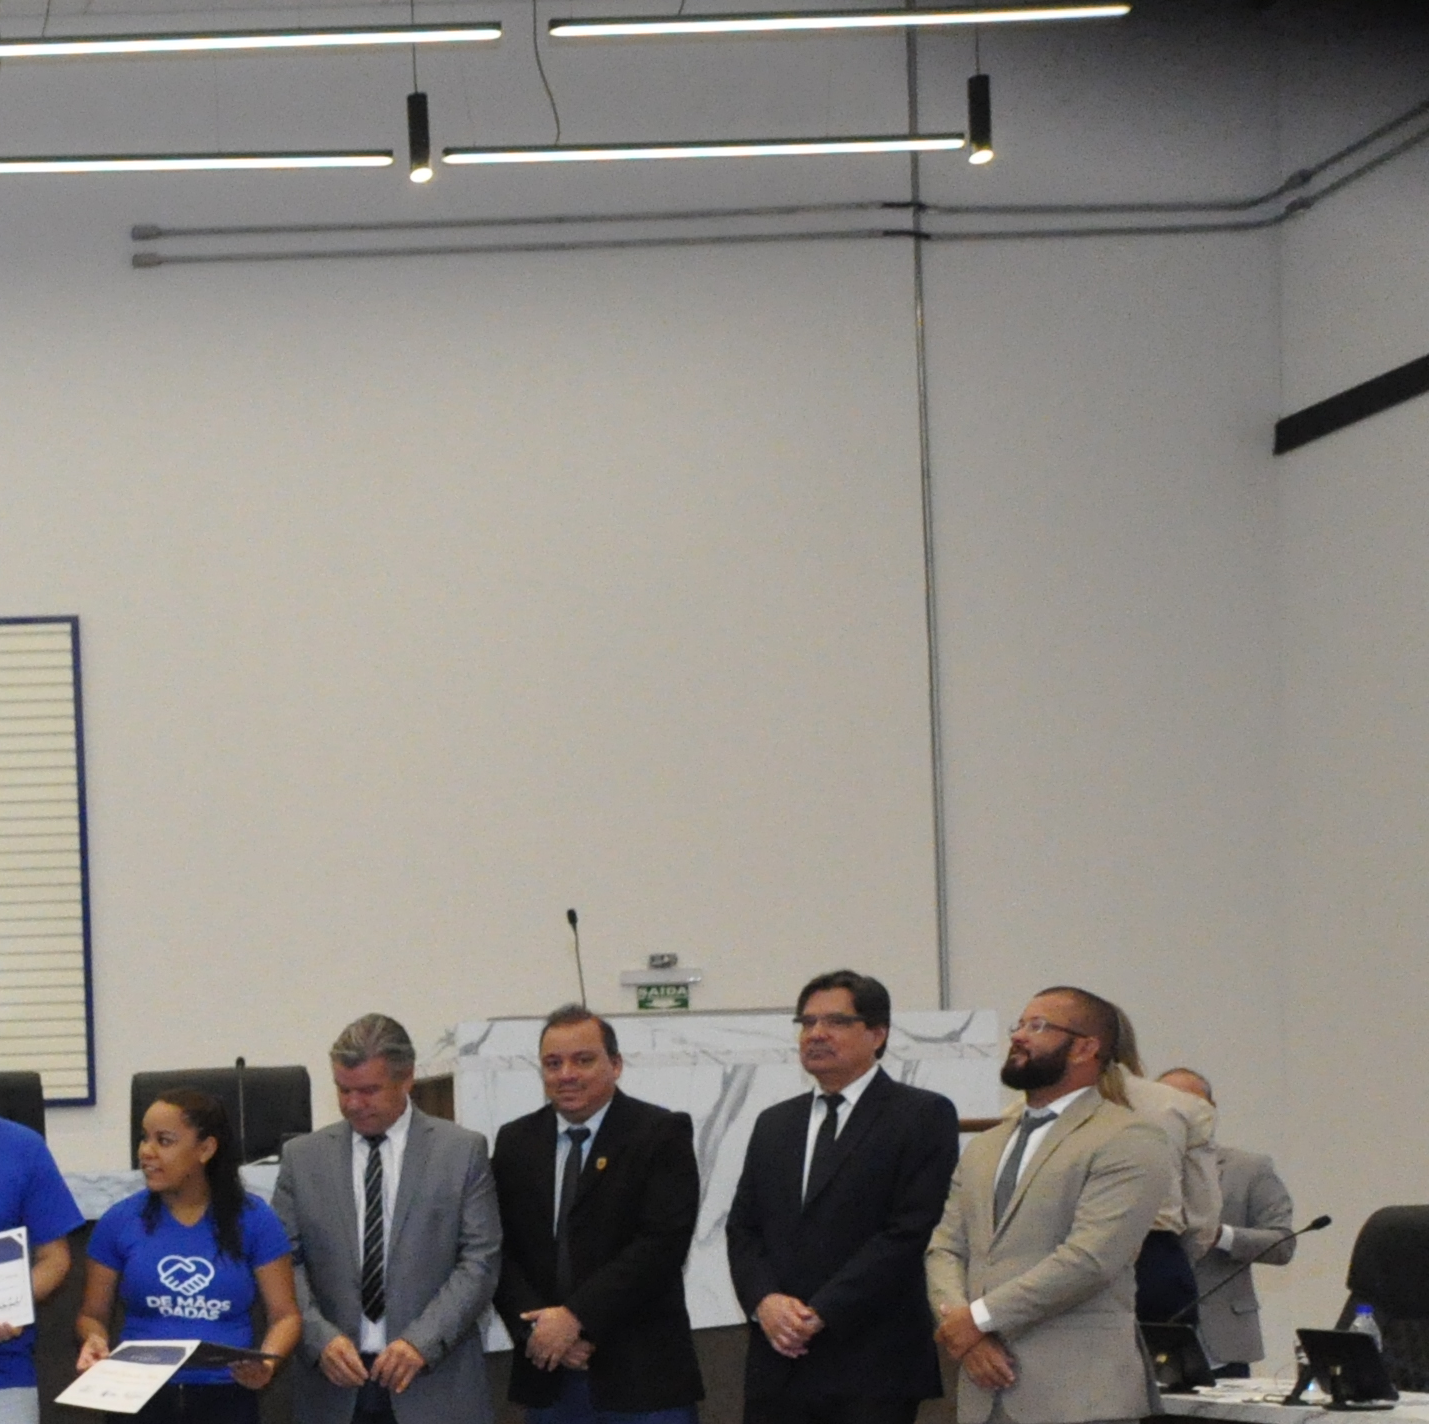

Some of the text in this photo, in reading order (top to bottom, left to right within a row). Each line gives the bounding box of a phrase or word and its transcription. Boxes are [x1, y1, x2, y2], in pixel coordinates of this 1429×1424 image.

[146, 1295, 231, 1312] DE MÃOS
[159, 1305, 220, 1321] DADAS
